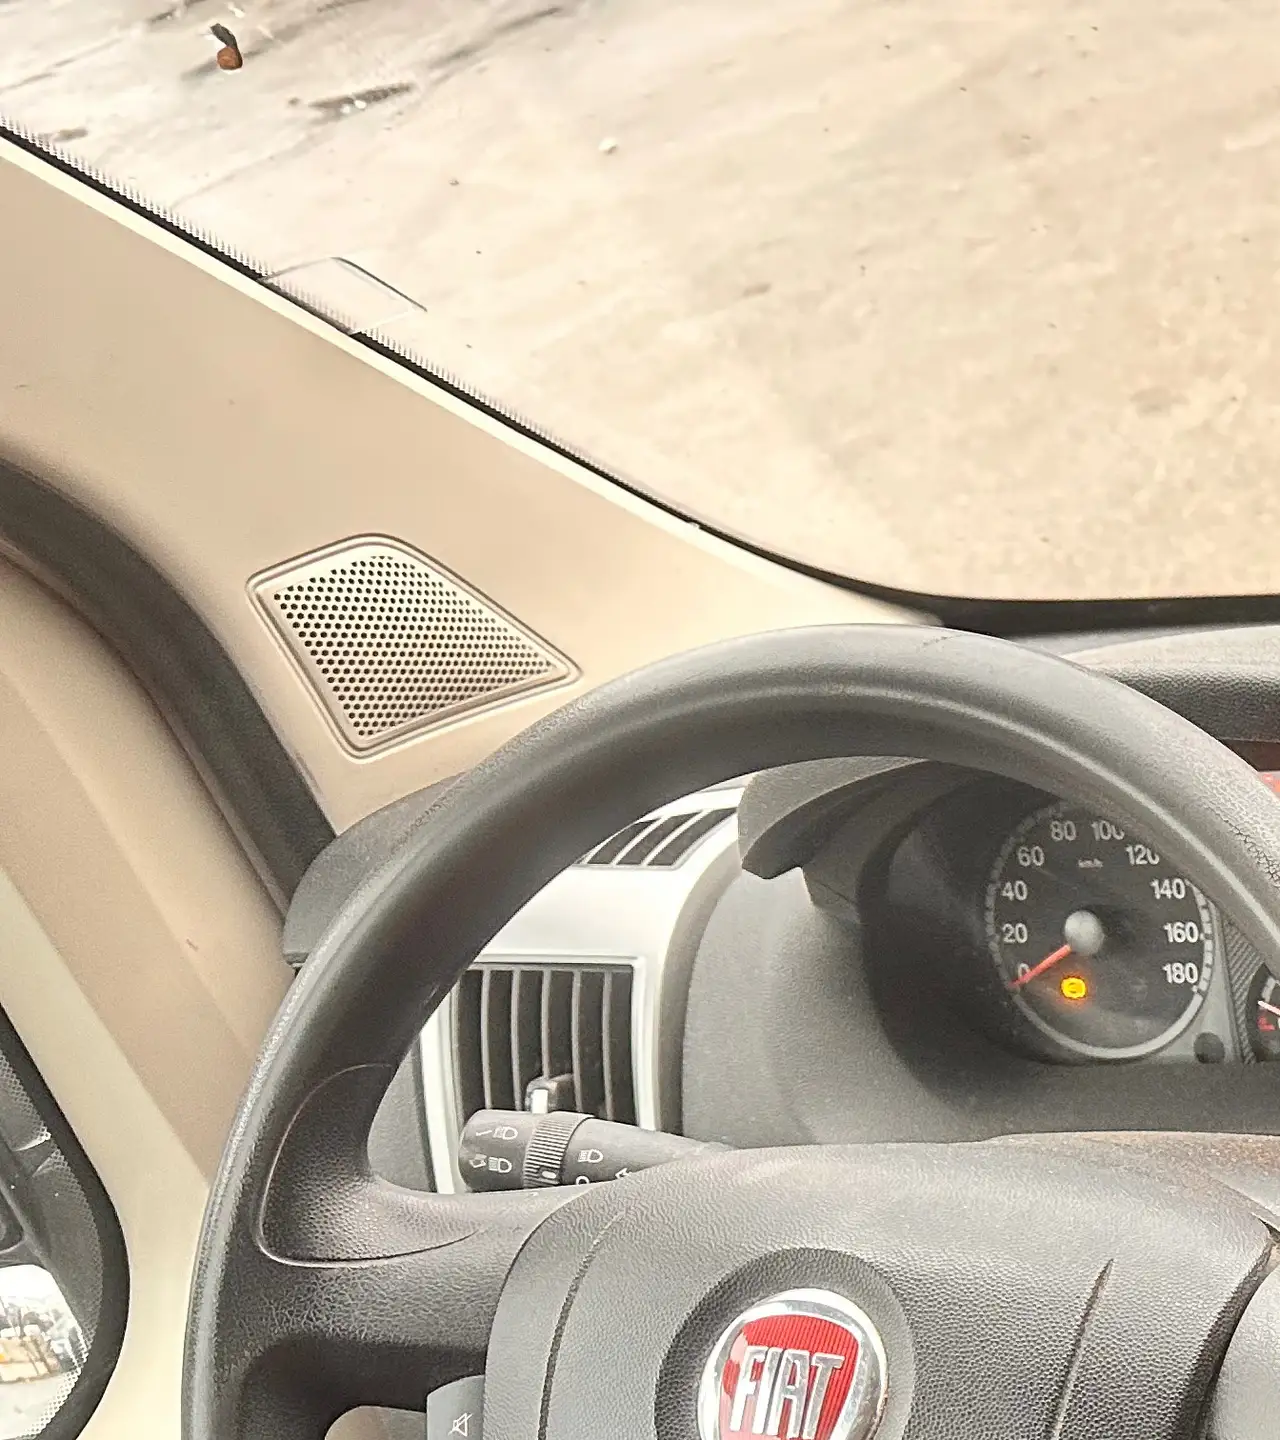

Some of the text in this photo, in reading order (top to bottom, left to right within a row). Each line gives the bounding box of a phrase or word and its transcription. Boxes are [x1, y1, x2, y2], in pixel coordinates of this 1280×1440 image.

[1051, 820, 1076, 841] 80
[1017, 846, 1045, 867] 60
[1001, 880, 1028, 900] 40
[1150, 878, 1186, 899] 140
[1002, 923, 1028, 944] 20
[1163, 921, 1199, 943] 160
[1162, 962, 1199, 984] 180
[729, 1345, 846, 1440] FIAT
